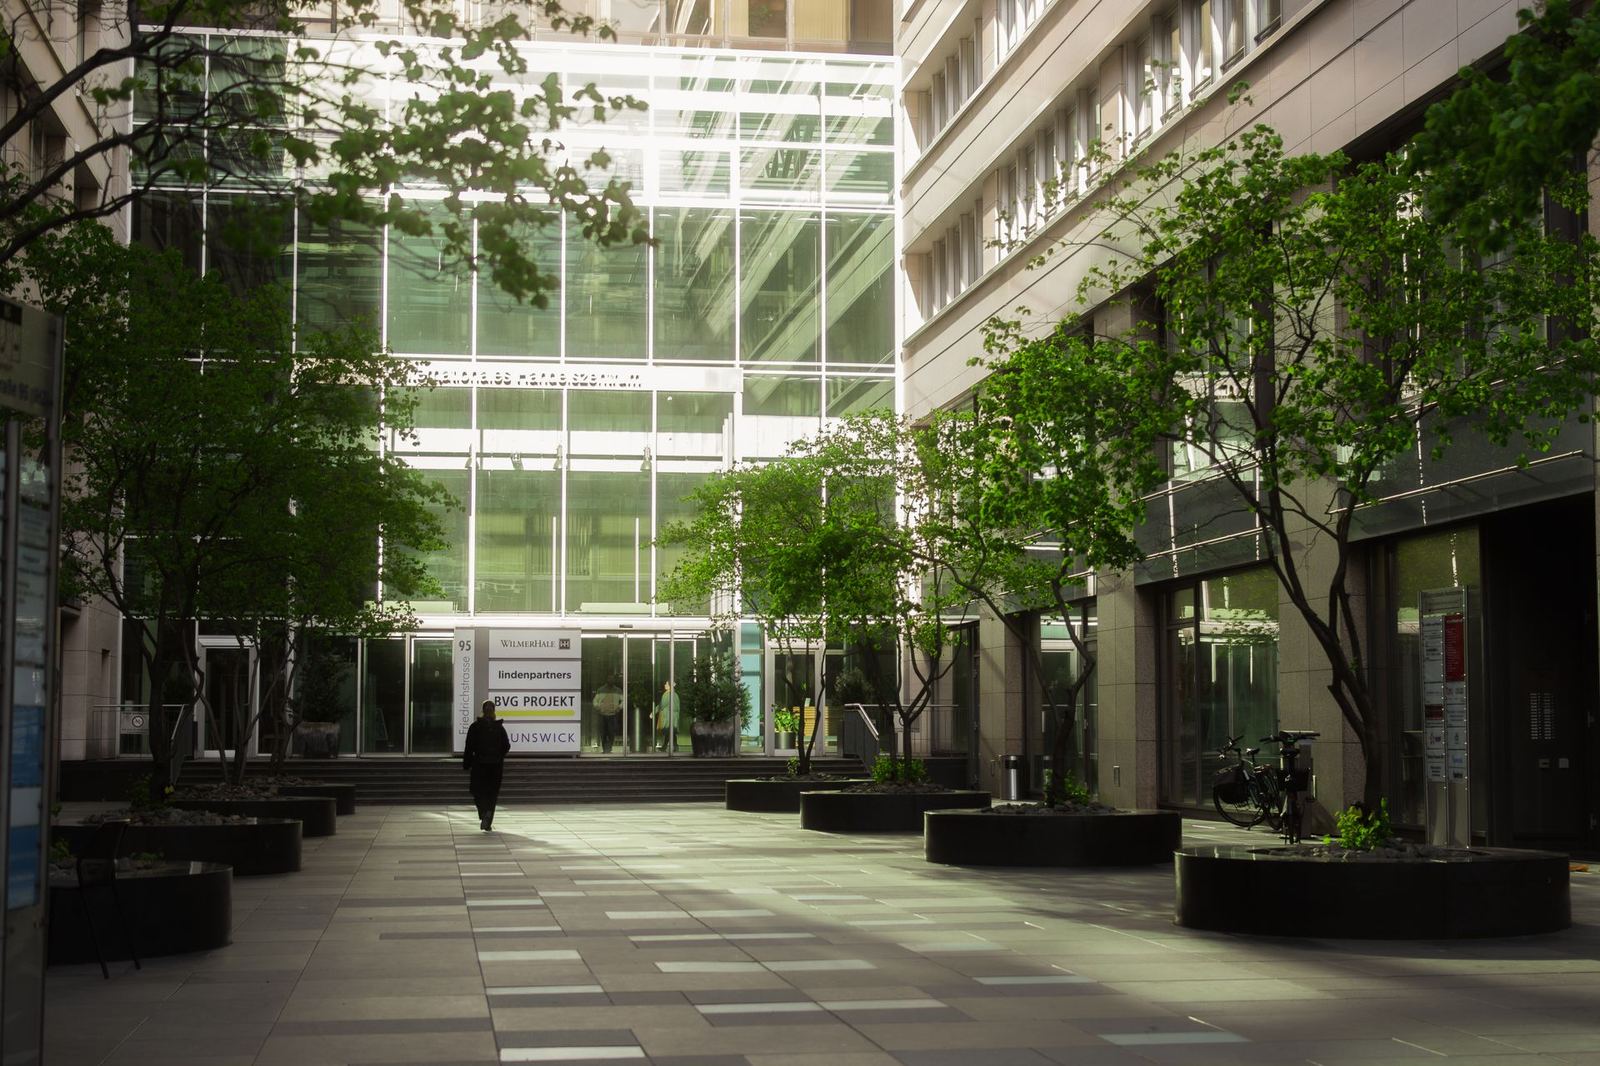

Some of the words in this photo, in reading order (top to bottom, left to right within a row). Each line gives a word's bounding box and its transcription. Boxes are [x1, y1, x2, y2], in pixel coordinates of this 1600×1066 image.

[459, 640, 471, 652] 95
[498, 670, 572, 680] lindenpartners
[459, 656, 471, 735] Friedrichstrasse
[494, 696, 519, 707] BVG
[523, 696, 575, 707] PROJEKT
[510, 732, 575, 743] UNSWICK
